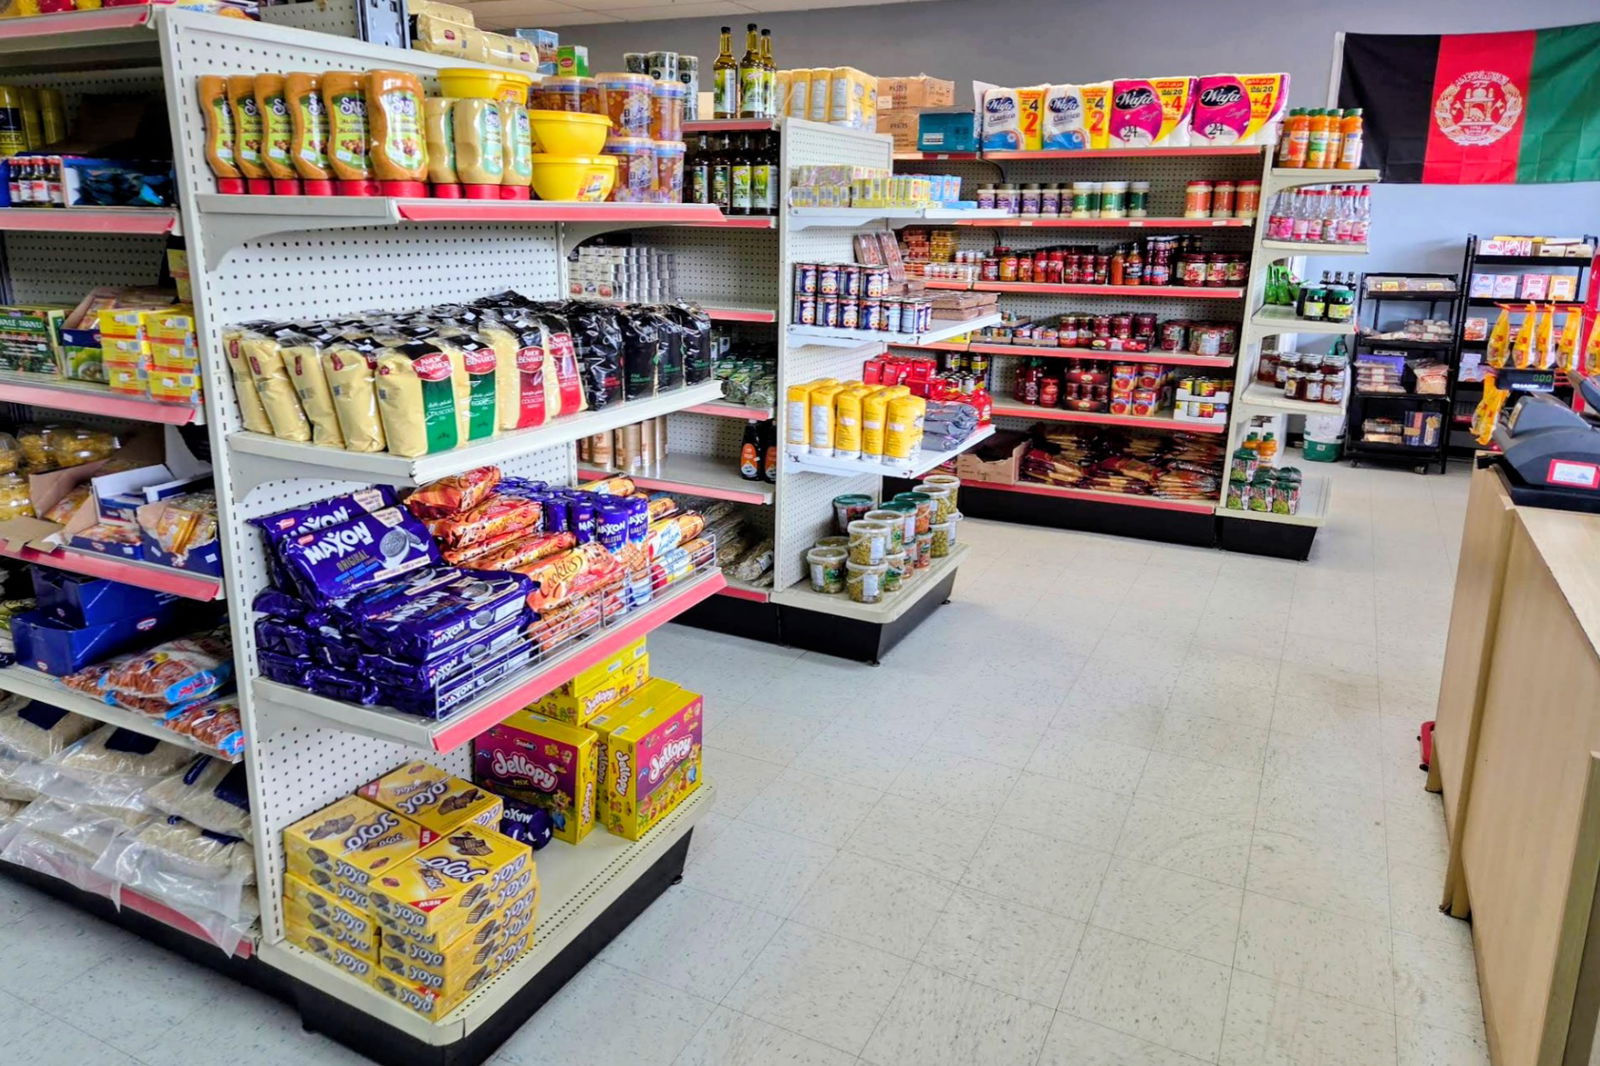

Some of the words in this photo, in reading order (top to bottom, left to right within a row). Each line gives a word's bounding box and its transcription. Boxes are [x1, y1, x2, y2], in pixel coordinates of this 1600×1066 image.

[987, 98, 1014, 112] Wafa
[1049, 98, 1079, 112] Wafa
[1115, 92, 1154, 108] Wafa
[1202, 88, 1242, 105] Wafa
[303, 521, 374, 565] MAXON
[432, 619, 465, 648] MAXON
[494, 752, 557, 789] Jellopy
[651, 737, 692, 781] Jellopy
[615, 752, 631, 797] Jellopy
[503, 808, 533, 824] MAXO
